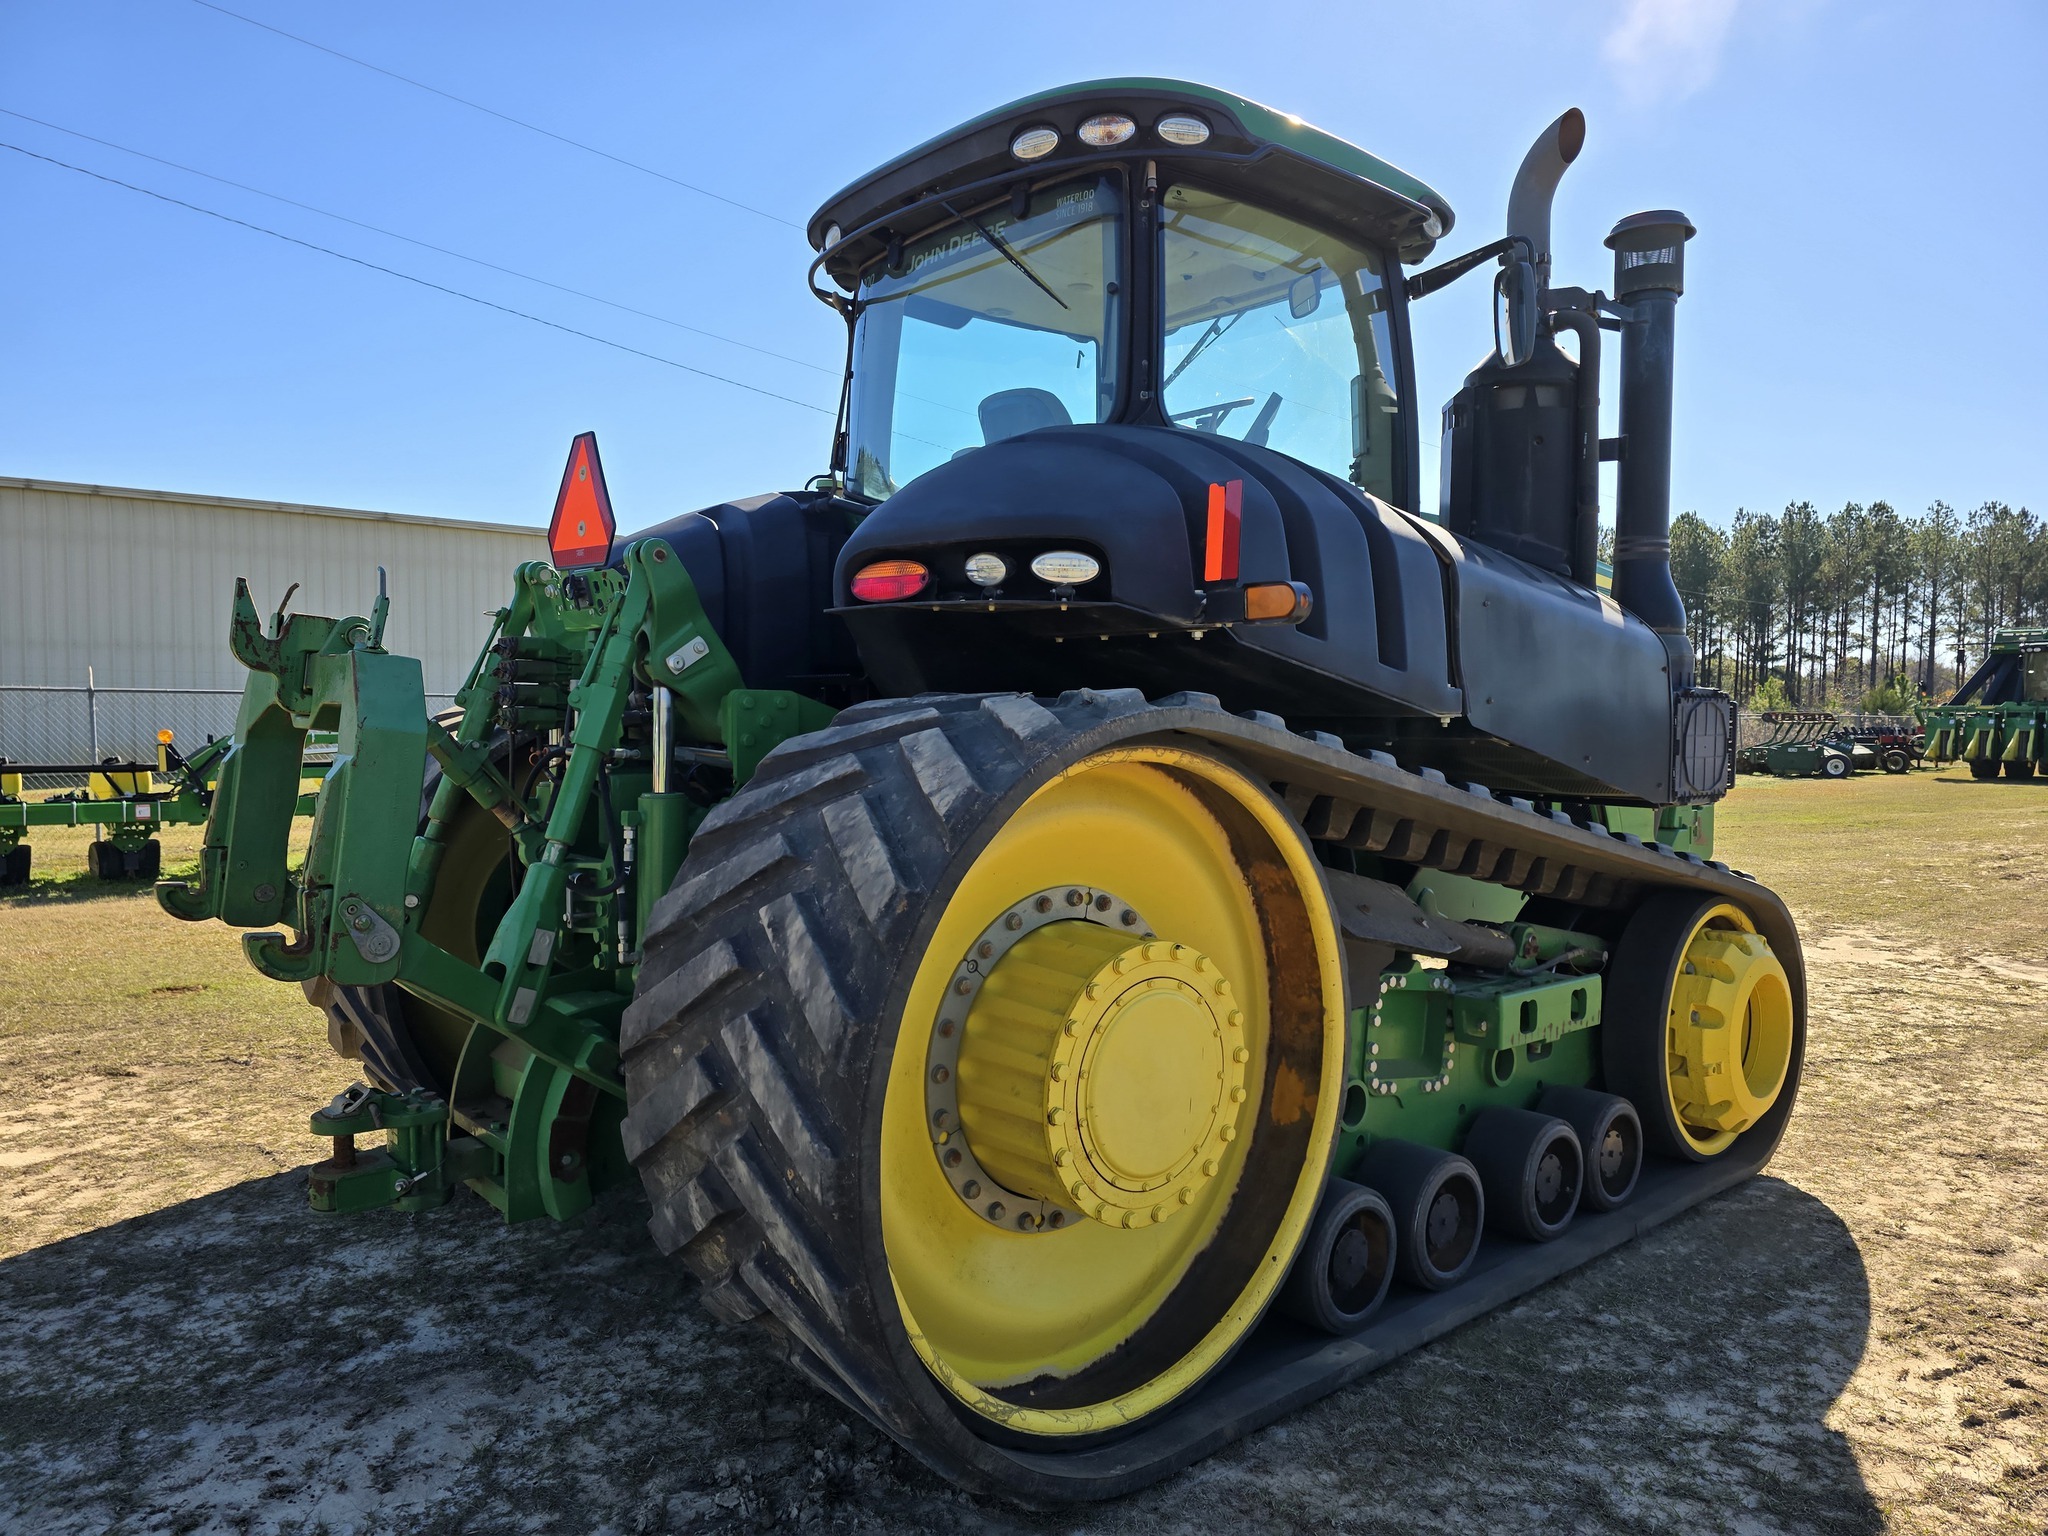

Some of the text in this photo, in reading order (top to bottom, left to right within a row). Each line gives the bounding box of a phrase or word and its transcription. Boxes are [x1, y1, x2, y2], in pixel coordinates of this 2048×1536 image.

[1056, 189, 1095, 208] WATERLOO
[1055, 201, 1094, 220] SINCE 1918
[907, 244, 946, 274] JOHN
